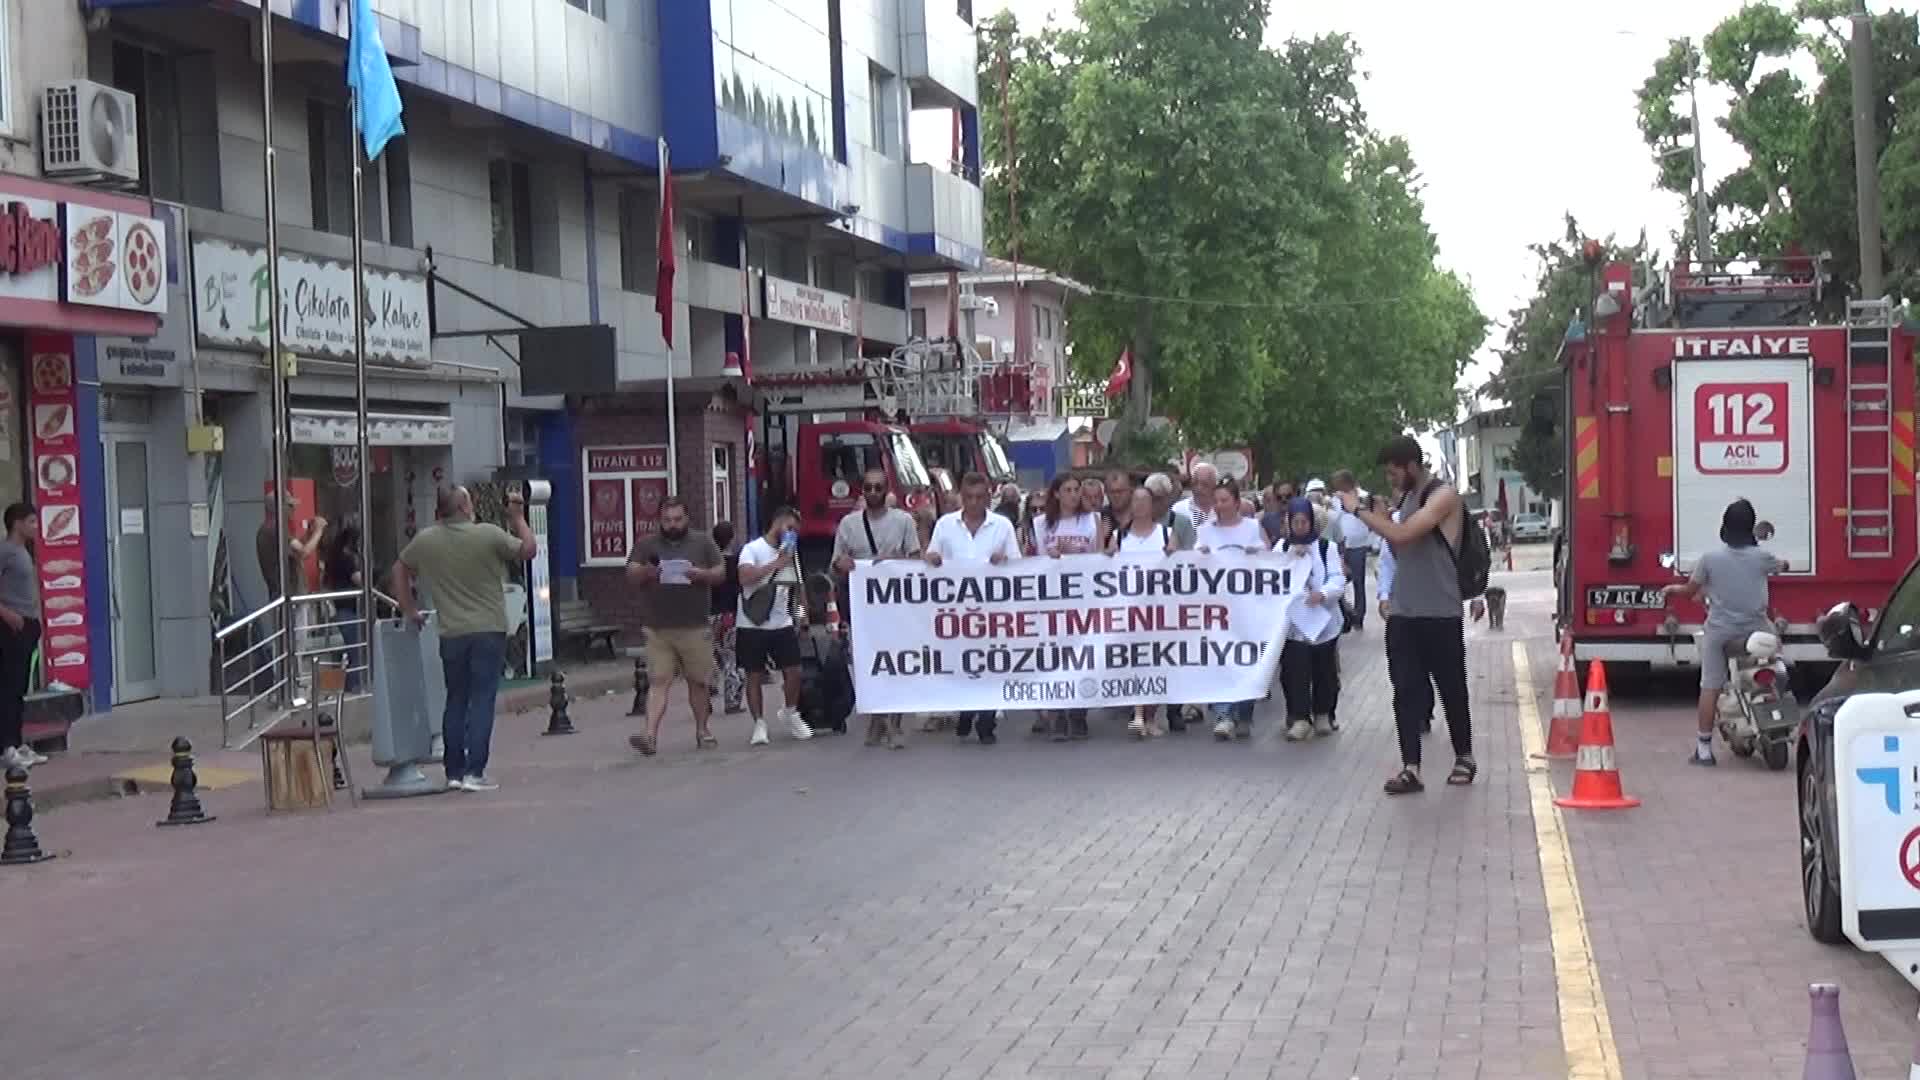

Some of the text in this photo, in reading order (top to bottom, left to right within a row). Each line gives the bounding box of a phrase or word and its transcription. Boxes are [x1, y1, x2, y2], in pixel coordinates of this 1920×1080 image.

[295, 278, 350, 326] Çikolata
[383, 290, 421, 329] Kahve
[1675, 335, 1810, 357] İTFAİYE
[1708, 392, 1775, 436] 112
[642, 455, 664, 467] 112
[594, 537, 623, 553] 112
[865, 563, 1292, 605] MÜCADELE SÜRÜYOR!
[1615, 591, 1638, 605] ACT
[934, 603, 1230, 640] ÖĞRETMENLER
[870, 644, 955, 677] ACİL
[961, 640, 1096, 680] ÇÖZÜM
[1002, 674, 1168, 701] ÖĞRETMEN SENDİKASI
